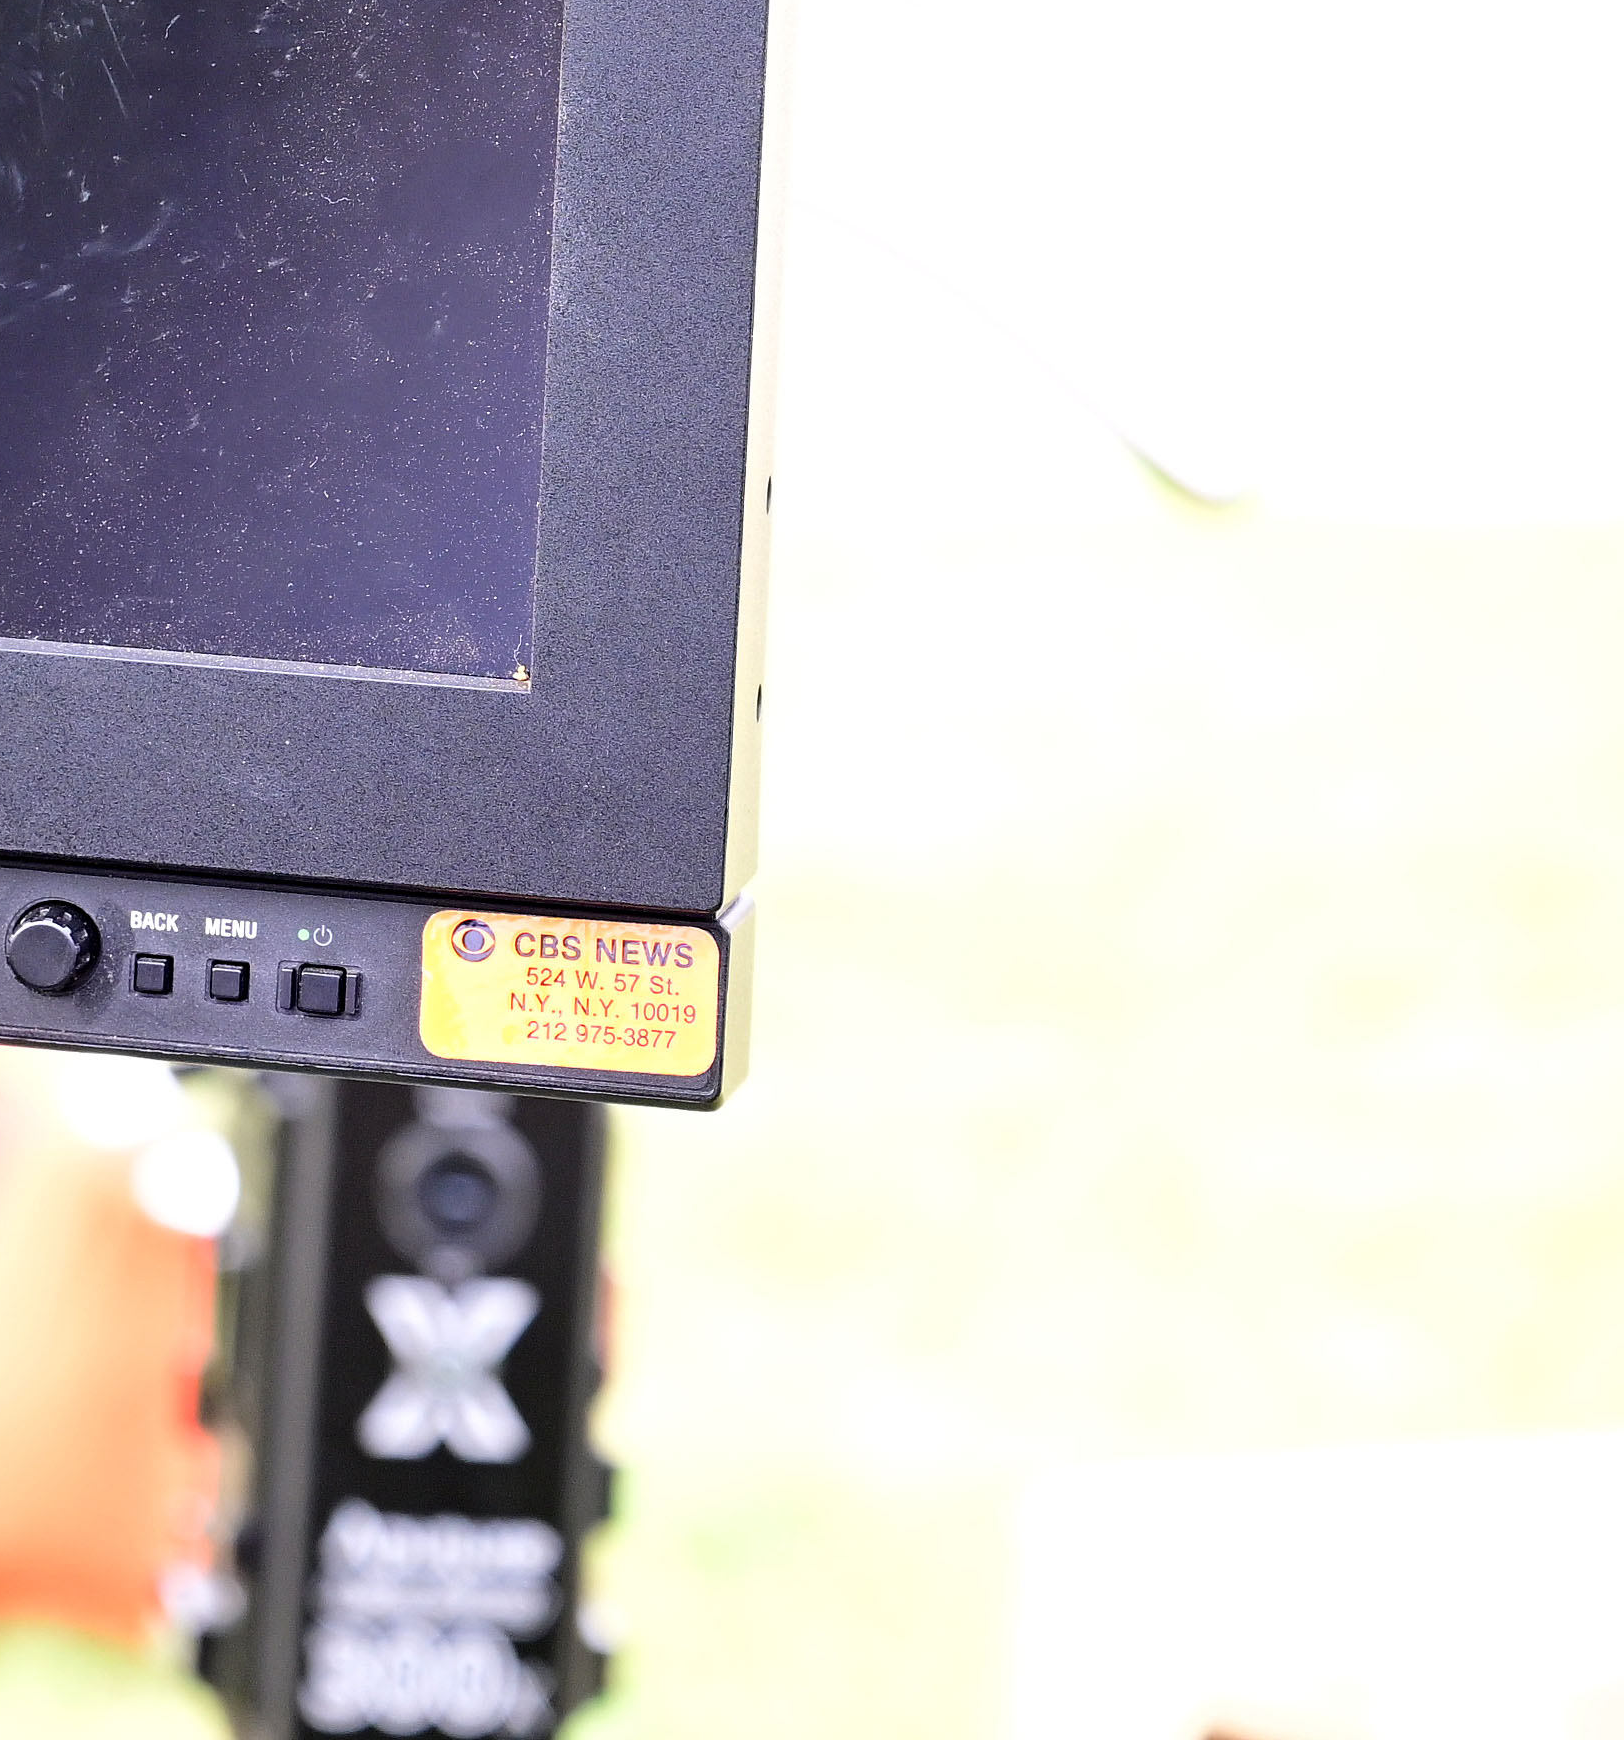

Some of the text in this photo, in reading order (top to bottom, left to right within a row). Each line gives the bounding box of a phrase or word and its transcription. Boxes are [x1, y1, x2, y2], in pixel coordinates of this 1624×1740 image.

[130, 910, 258, 940] BACK MENU
[514, 932, 694, 969] CBS NEWS
[526, 967, 679, 996] 524 W. 57 St.
[510, 992, 696, 1024] N.Y., N.Y. 10019
[526, 1021, 677, 1049] 212 975-3877
